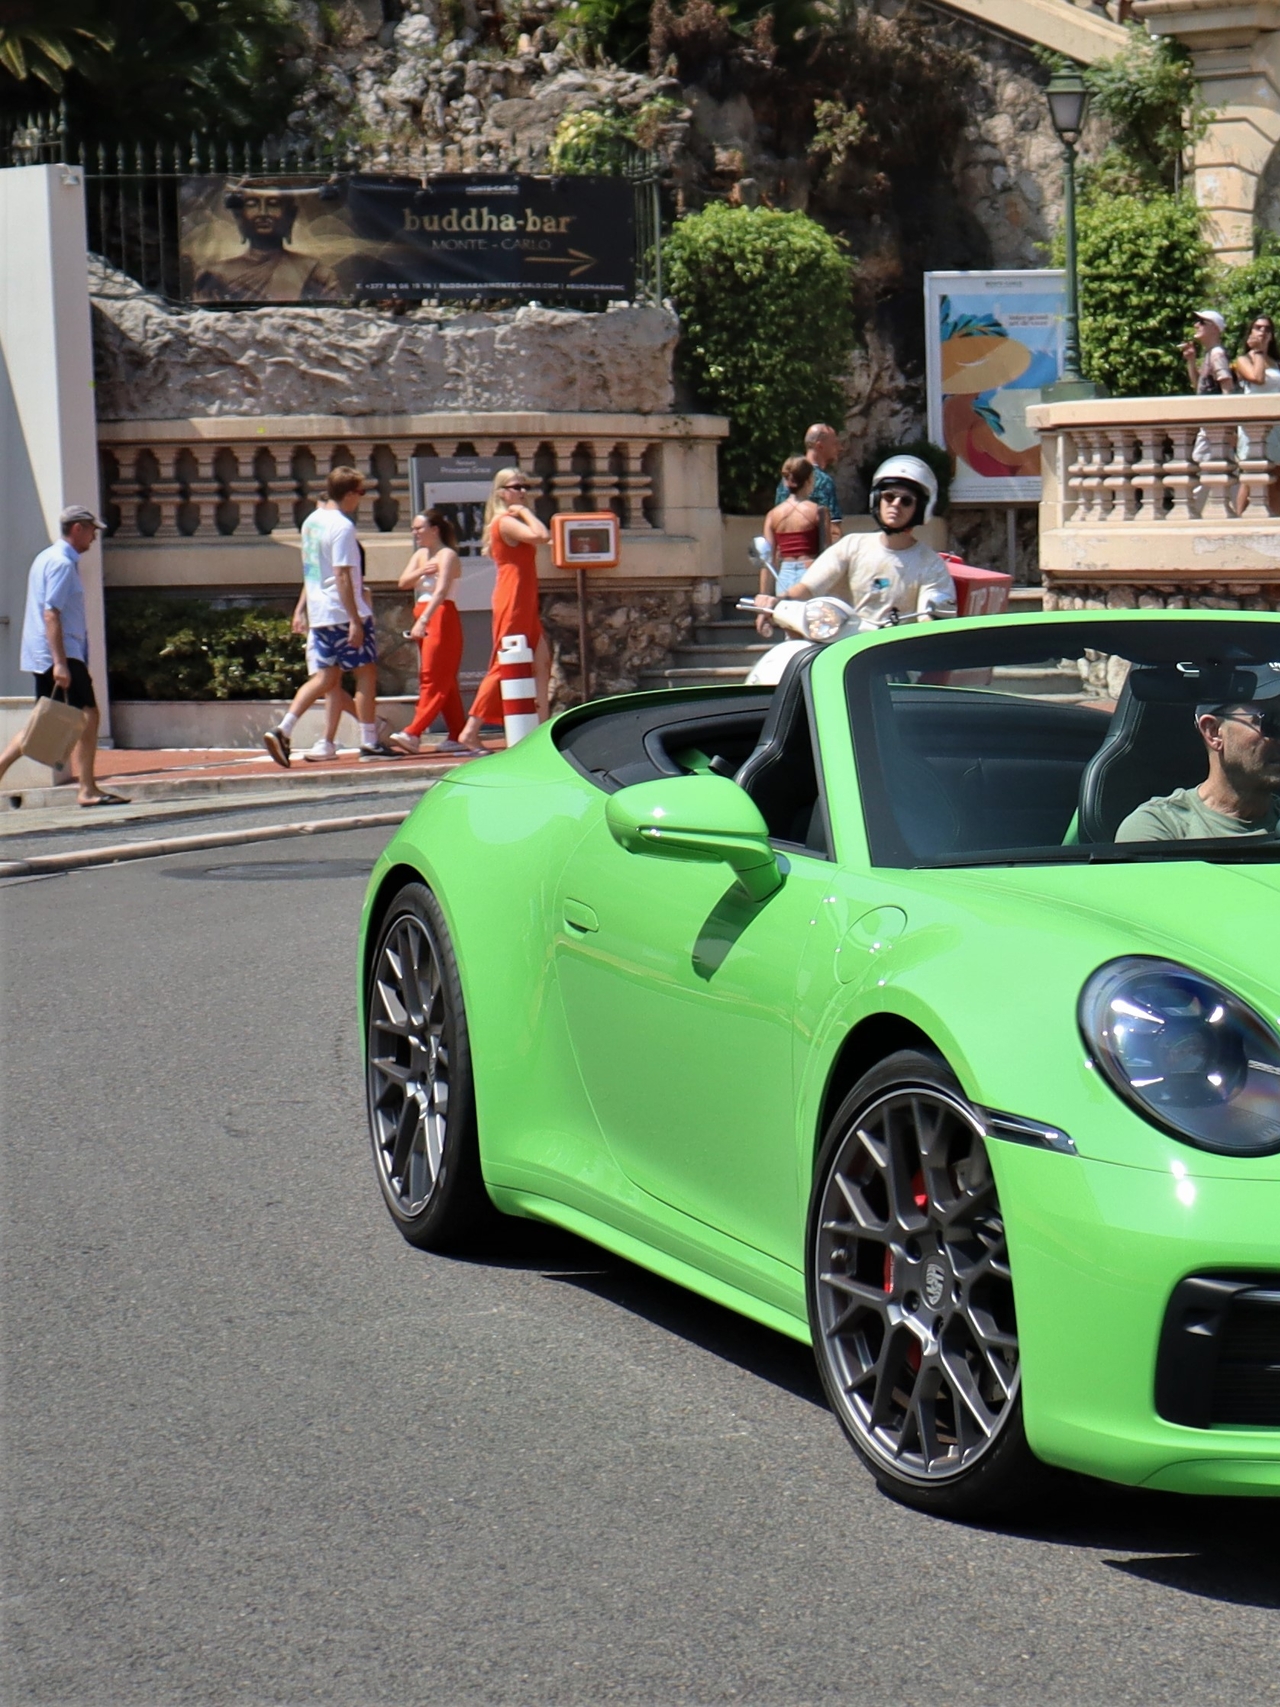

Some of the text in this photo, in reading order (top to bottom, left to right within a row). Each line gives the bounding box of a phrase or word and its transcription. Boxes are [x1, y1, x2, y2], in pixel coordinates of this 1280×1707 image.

[403, 206, 572, 233] buddha-bar
[431, 239, 487, 250] MONTE
[501, 239, 551, 250] CARLO
